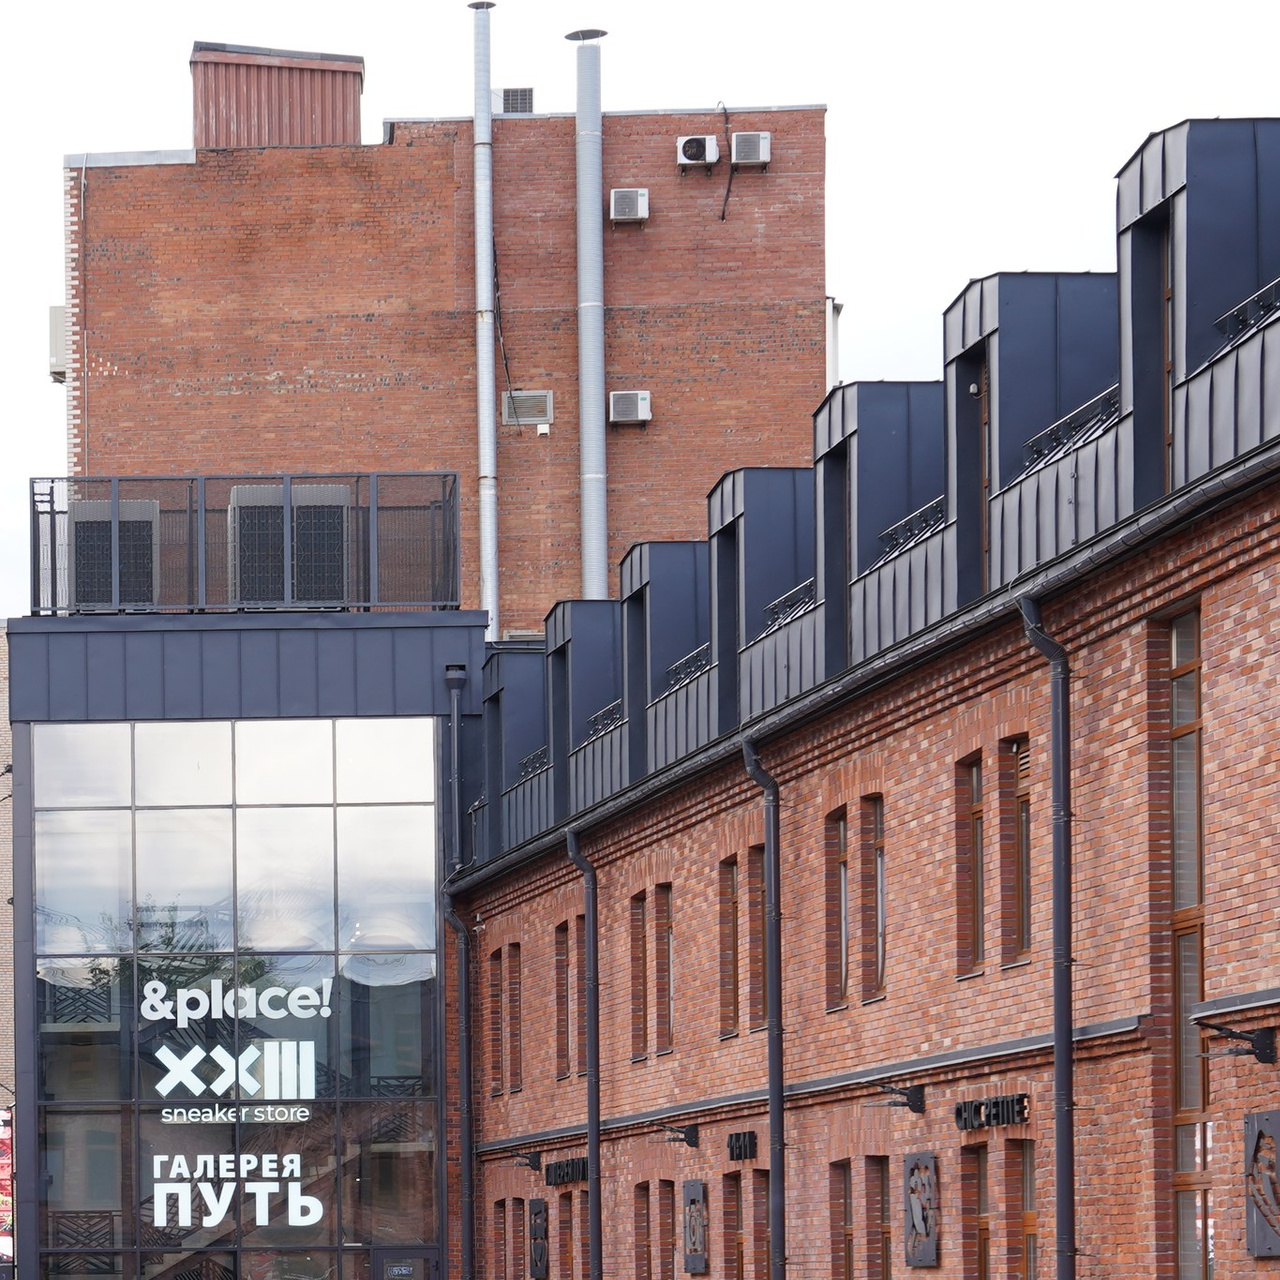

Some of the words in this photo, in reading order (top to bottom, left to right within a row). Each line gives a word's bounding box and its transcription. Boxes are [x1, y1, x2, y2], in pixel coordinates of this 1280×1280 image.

[140, 978, 334, 1028] &place!
[161, 1105, 249, 1123] sneaker
[254, 1104, 310, 1123] store
[955, 1099, 981, 1130] CHIC
[984, 1094, 1029, 1127] PETITE
[152, 1152, 302, 1179] ГАЛЕРЕЯ
[152, 1182, 325, 1228] ПУТЬ
